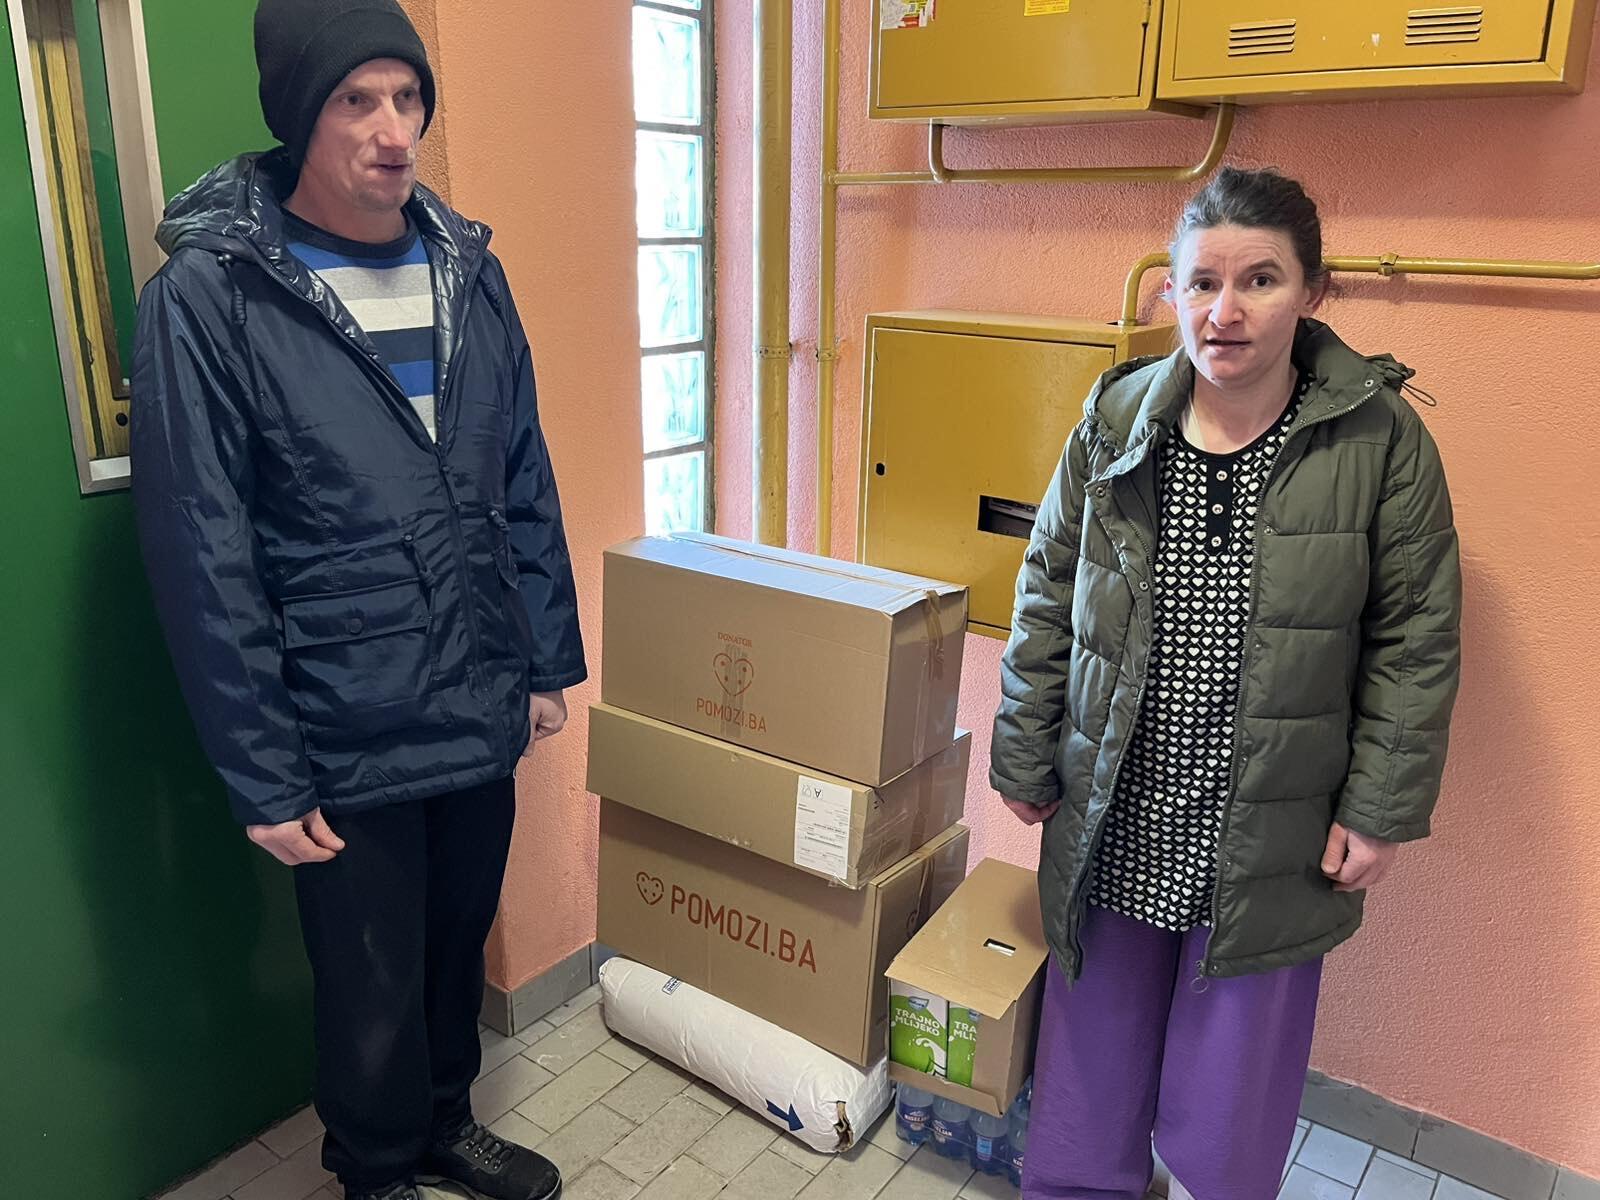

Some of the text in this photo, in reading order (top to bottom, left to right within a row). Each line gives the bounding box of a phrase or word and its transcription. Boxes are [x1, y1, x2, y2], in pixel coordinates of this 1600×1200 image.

[717, 631, 753, 648] DONATOR
[696, 697, 767, 733] POMOZI.BA
[670, 884, 817, 973] POMOZI.BA
[895, 1008, 940, 1029] TRAJNO
[895, 1015, 940, 1037] MLIJEKO
[954, 1021, 977, 1034] TRA
